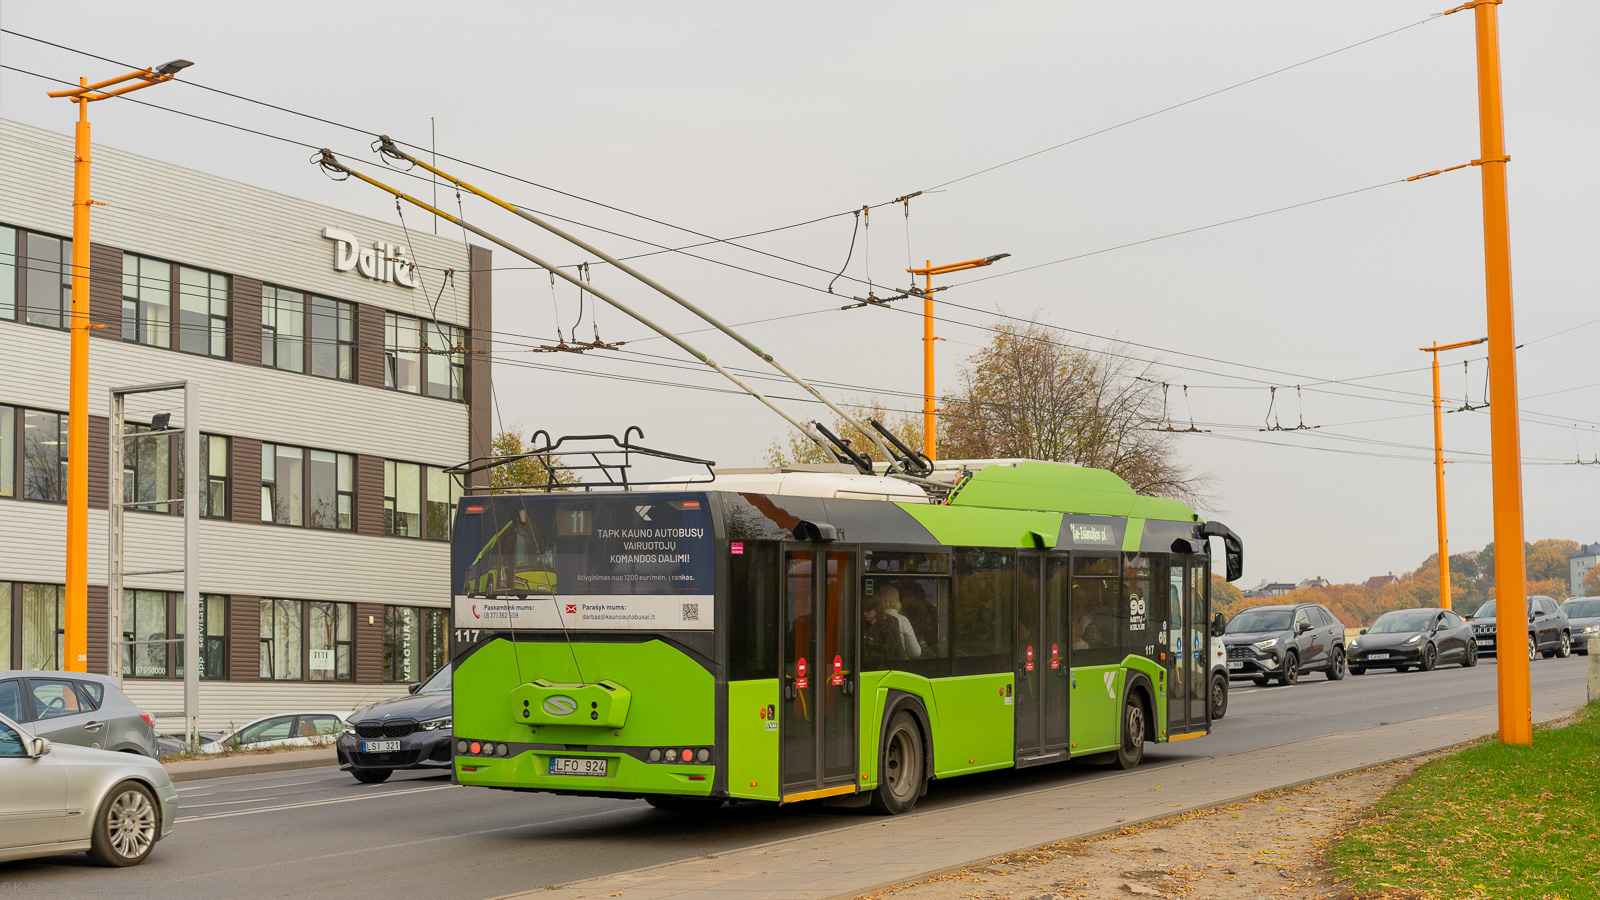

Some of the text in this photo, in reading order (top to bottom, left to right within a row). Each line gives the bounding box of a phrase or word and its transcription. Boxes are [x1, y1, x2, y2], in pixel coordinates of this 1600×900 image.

[571, 511, 584, 532] 11
[598, 528, 704, 540] TAPK KAUNO AUTOBUSŲ
[624, 542, 676, 552] VAIRUOTOJŲ
[610, 554, 690, 563] KOMANDOS DALIMI!
[577, 574, 610, 582] Atlyginimas
[455, 630, 480, 642] 117
[1145, 645, 1154, 655] 117
[366, 742, 380, 750] LSI
[556, 760, 578, 771] LFO
[586, 760, 604, 772] 924
